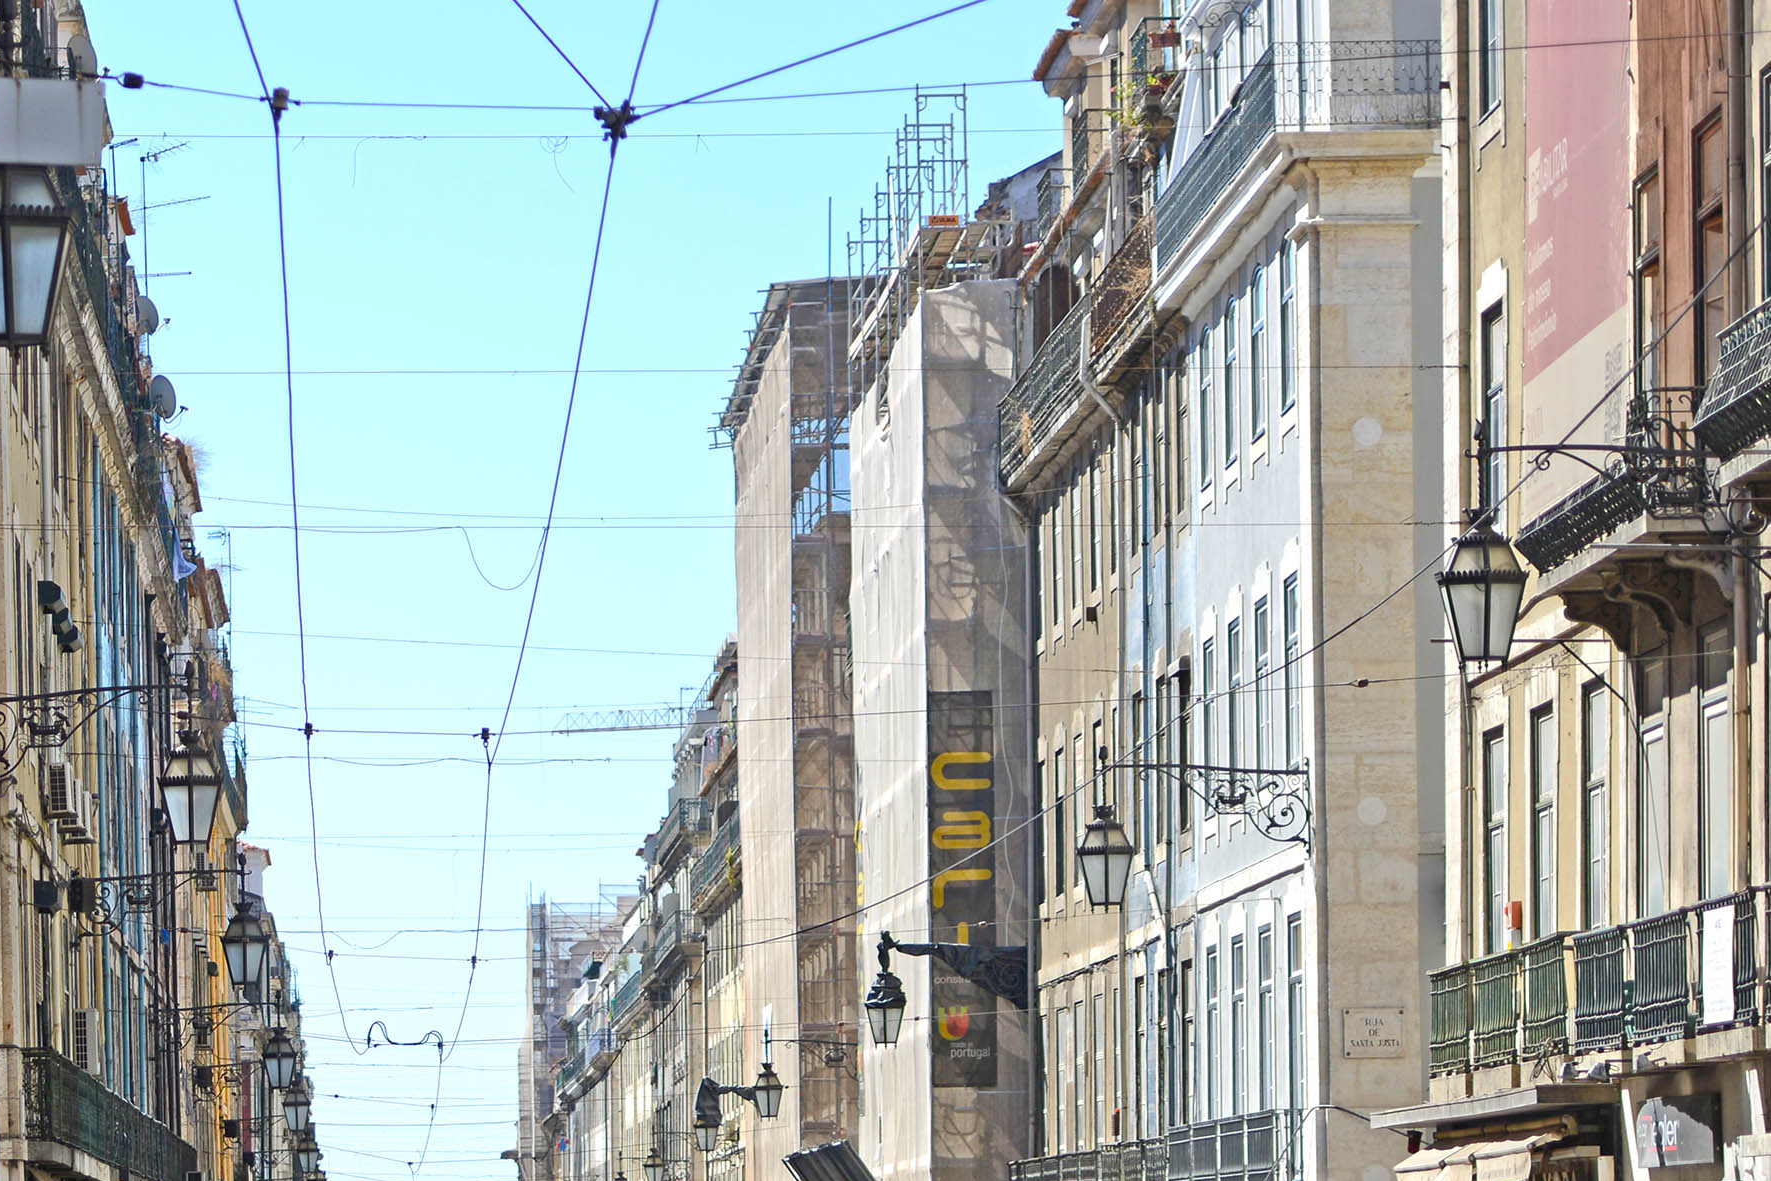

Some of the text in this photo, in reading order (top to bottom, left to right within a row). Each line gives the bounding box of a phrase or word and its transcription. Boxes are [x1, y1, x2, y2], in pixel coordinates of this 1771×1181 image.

[1365, 1017, 1384, 1026] RUA
[1368, 1029, 1380, 1037] DE
[1350, 1039, 1400, 1048] SANTA JUSTA
[950, 1047, 991, 1060] portugal
